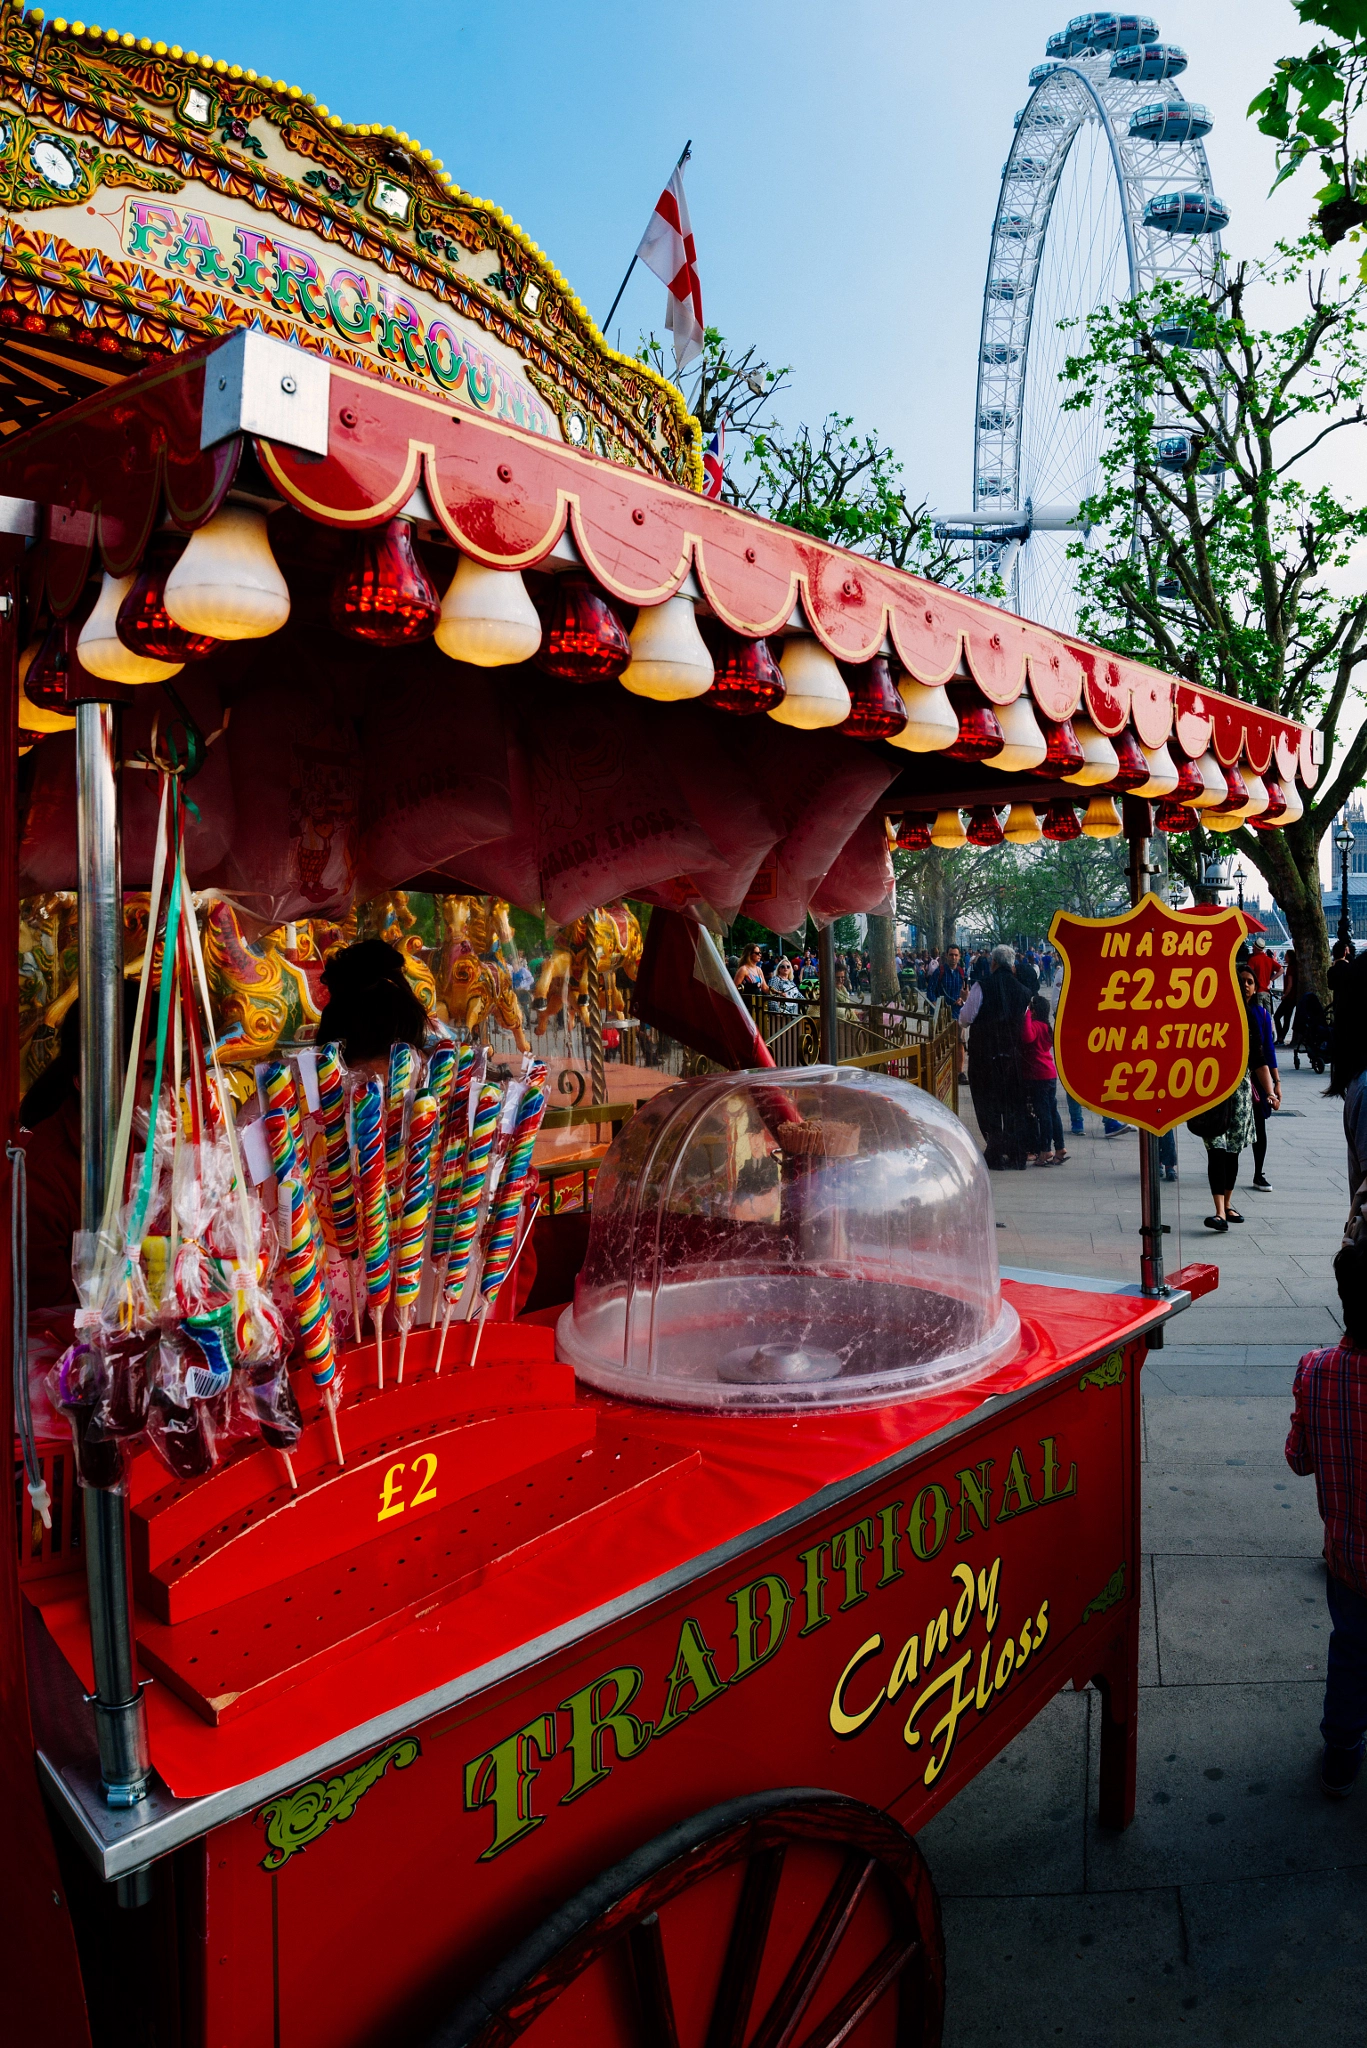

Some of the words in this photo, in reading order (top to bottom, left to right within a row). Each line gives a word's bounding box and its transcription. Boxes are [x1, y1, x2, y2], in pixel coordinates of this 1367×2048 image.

[128, 199, 549, 438] FAIRGROUND
[605, 807, 676, 850] FLOSS
[1101, 932, 1131, 958] IN
[1135, 931, 1153, 957] A
[1161, 930, 1213, 956] BAG
[1097, 967, 1218, 1011] £2.50
[1087, 1026, 1127, 1053] ON
[1131, 1025, 1148, 1050] A
[1156, 1022, 1229, 1049] STICK
[1101, 1057, 1220, 1103] £2.00
[377, 1453, 438, 1522] £2
[463, 1436, 1078, 1864] TRADITIONAL
[829, 1556, 1002, 1739] Candy
[904, 1599, 1049, 1787] Floss
